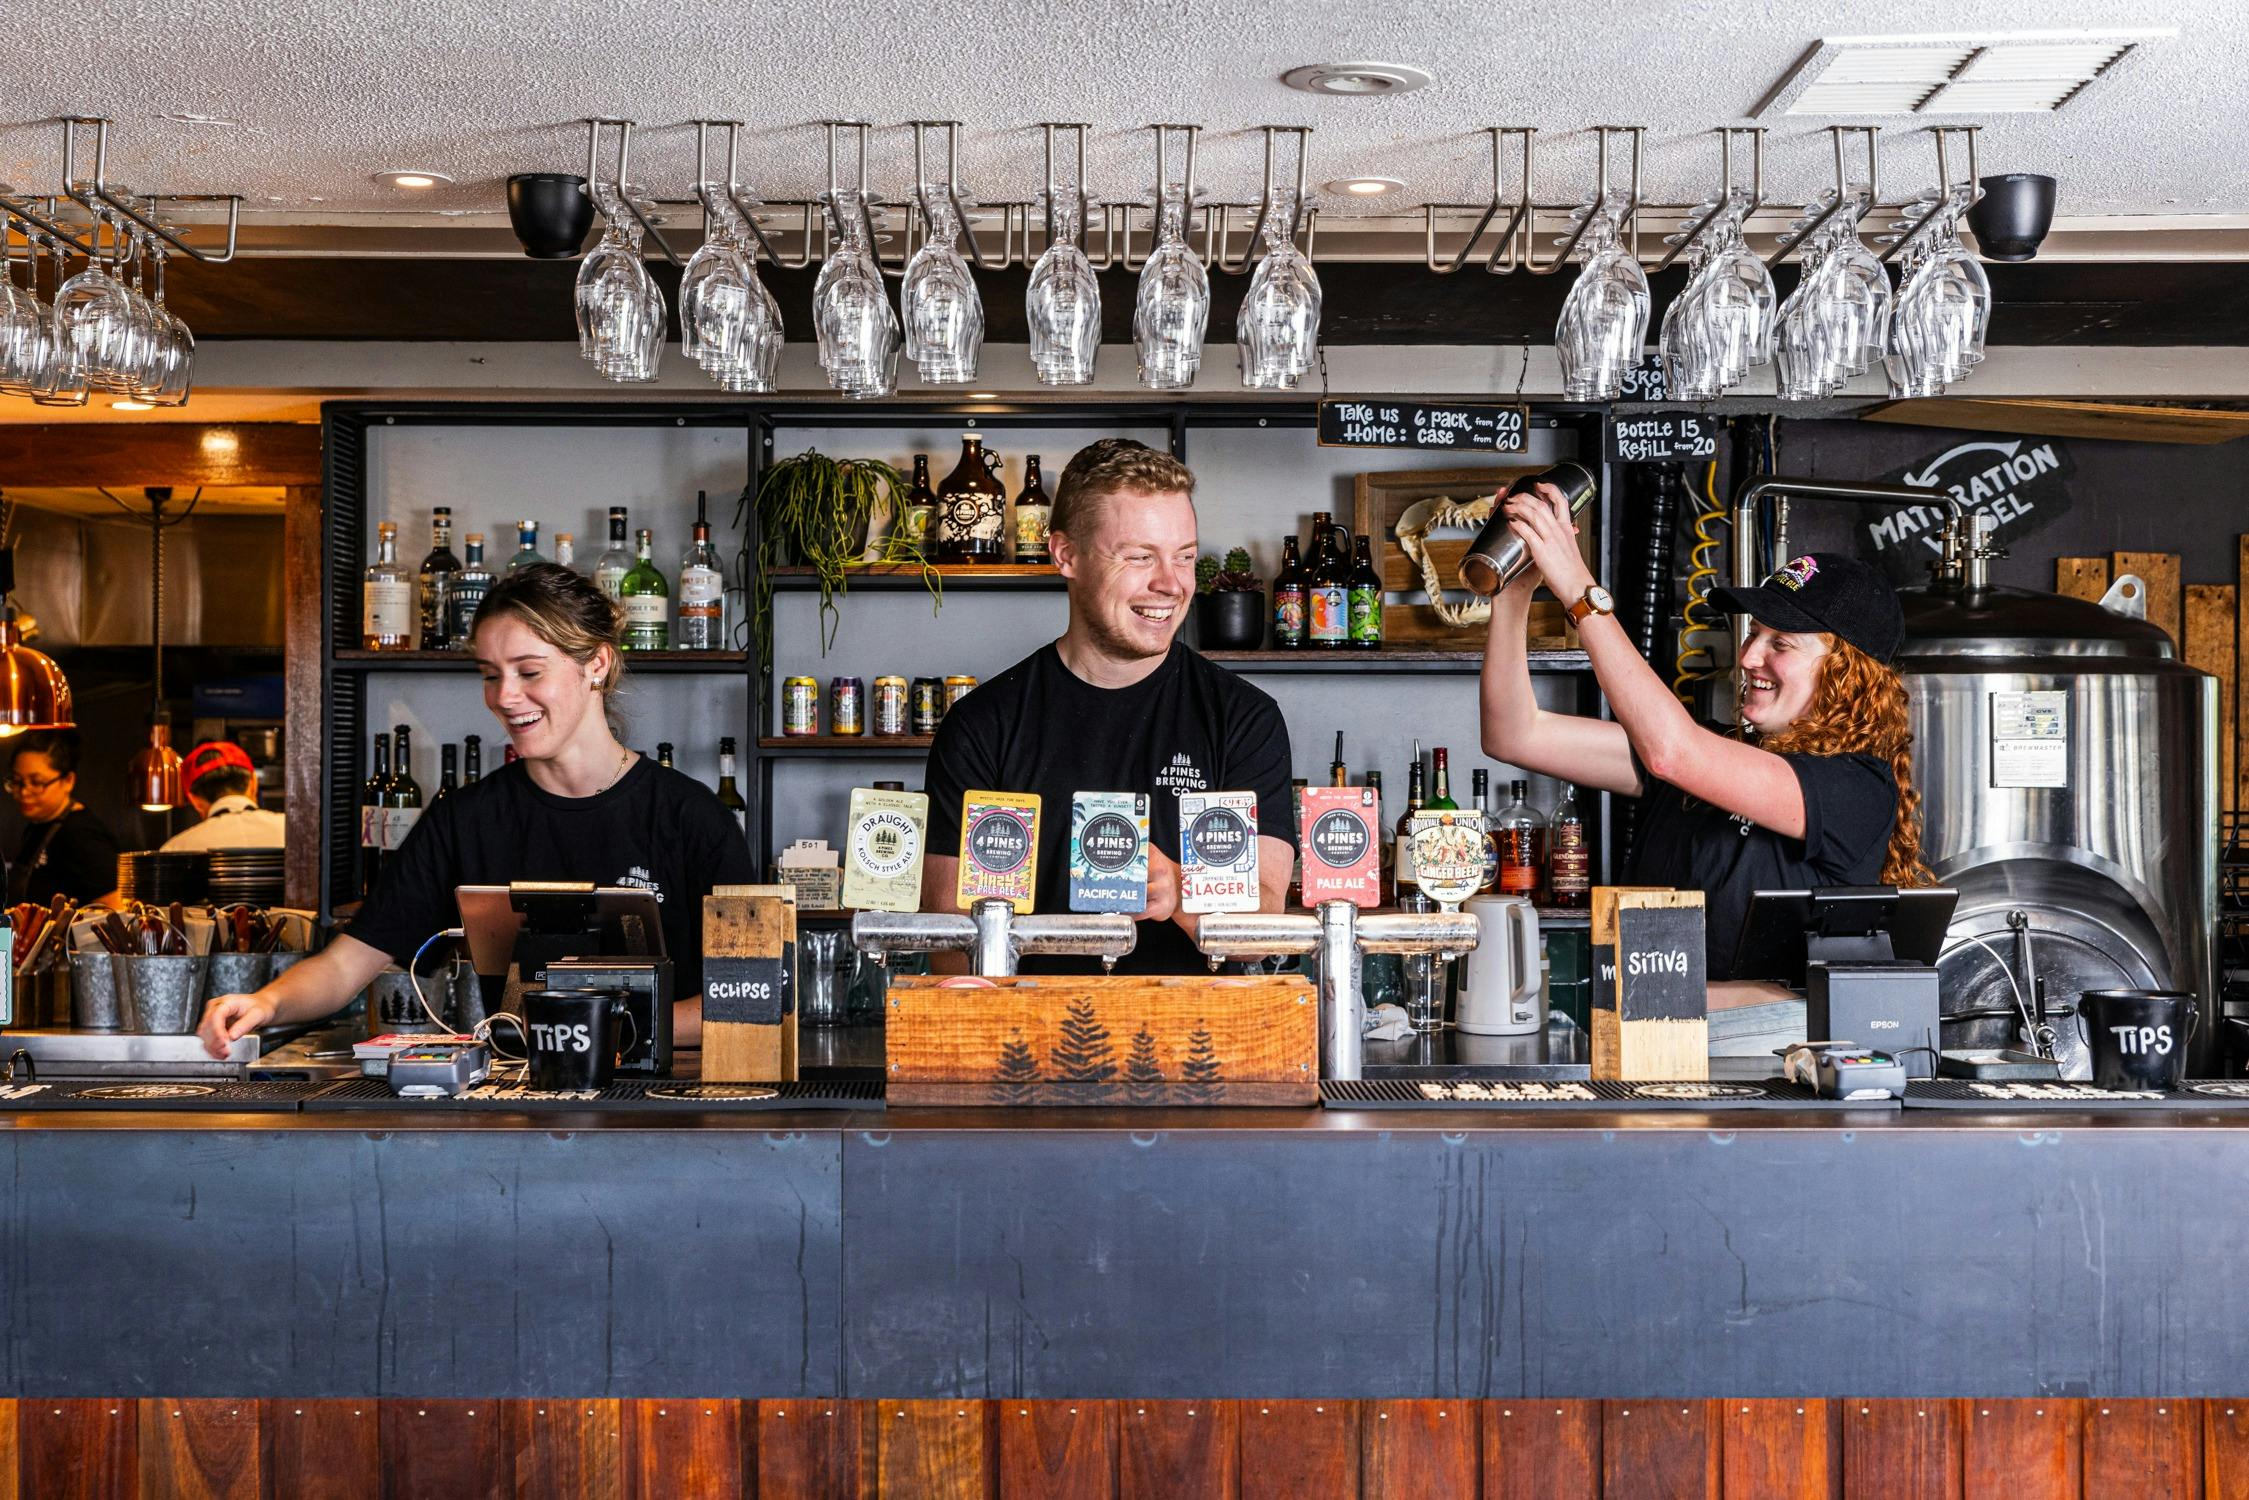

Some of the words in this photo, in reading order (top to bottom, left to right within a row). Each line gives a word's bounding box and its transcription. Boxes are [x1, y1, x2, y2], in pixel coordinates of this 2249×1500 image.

[1335, 404, 1374, 425] Take
[1380, 408, 1399, 423] us
[1414, 409, 1426, 426] 6
[1431, 411, 1472, 432] pack
[1475, 417, 1493, 427] from
[1496, 411, 1521, 431] 20
[1681, 419, 1700, 438] 15
[1417, 429, 1455, 444] case
[1473, 434, 1492, 444] from
[1496, 432, 1521, 450] 60
[1673, 442, 1694, 450] from
[1692, 437, 1715, 455] 20
[1922, 493, 2035, 556] VSEL
[1161, 767, 1168, 776] 4
[1170, 767, 1201, 778] PINES
[1156, 777, 1207, 789] BREWING
[862, 814, 913, 836] DRAUGHT
[1455, 818, 1485, 836] UNION
[976, 836, 985, 847] 4
[987, 836, 1023, 850] PINES
[1086, 837, 1095, 848] 4
[1097, 837, 1133, 849] PINES
[1196, 831, 1204, 842] 4
[1206, 831, 1242, 842] PINES
[1317, 833, 1325, 844] 4
[1327, 833, 1363, 844] PINES
[881, 863, 902, 873] STYLE
[902, 851, 913, 865] ALE
[1420, 867, 1454, 879] GINGER
[1455, 867, 1478, 878] BEER
[616, 877, 626, 886] 4
[627, 878, 660, 891] PINES
[1195, 883, 1245, 895] LAGER
[1316, 878, 1342, 889] PALE
[1344, 878, 1365, 889] ALE
[977, 886, 997, 895] PALE
[999, 886, 1016, 896] ALE
[1079, 889, 1117, 899] PACIFIC
[1119, 890, 1138, 900] ALE
[1871, 1021, 1899, 1029] EPSON
